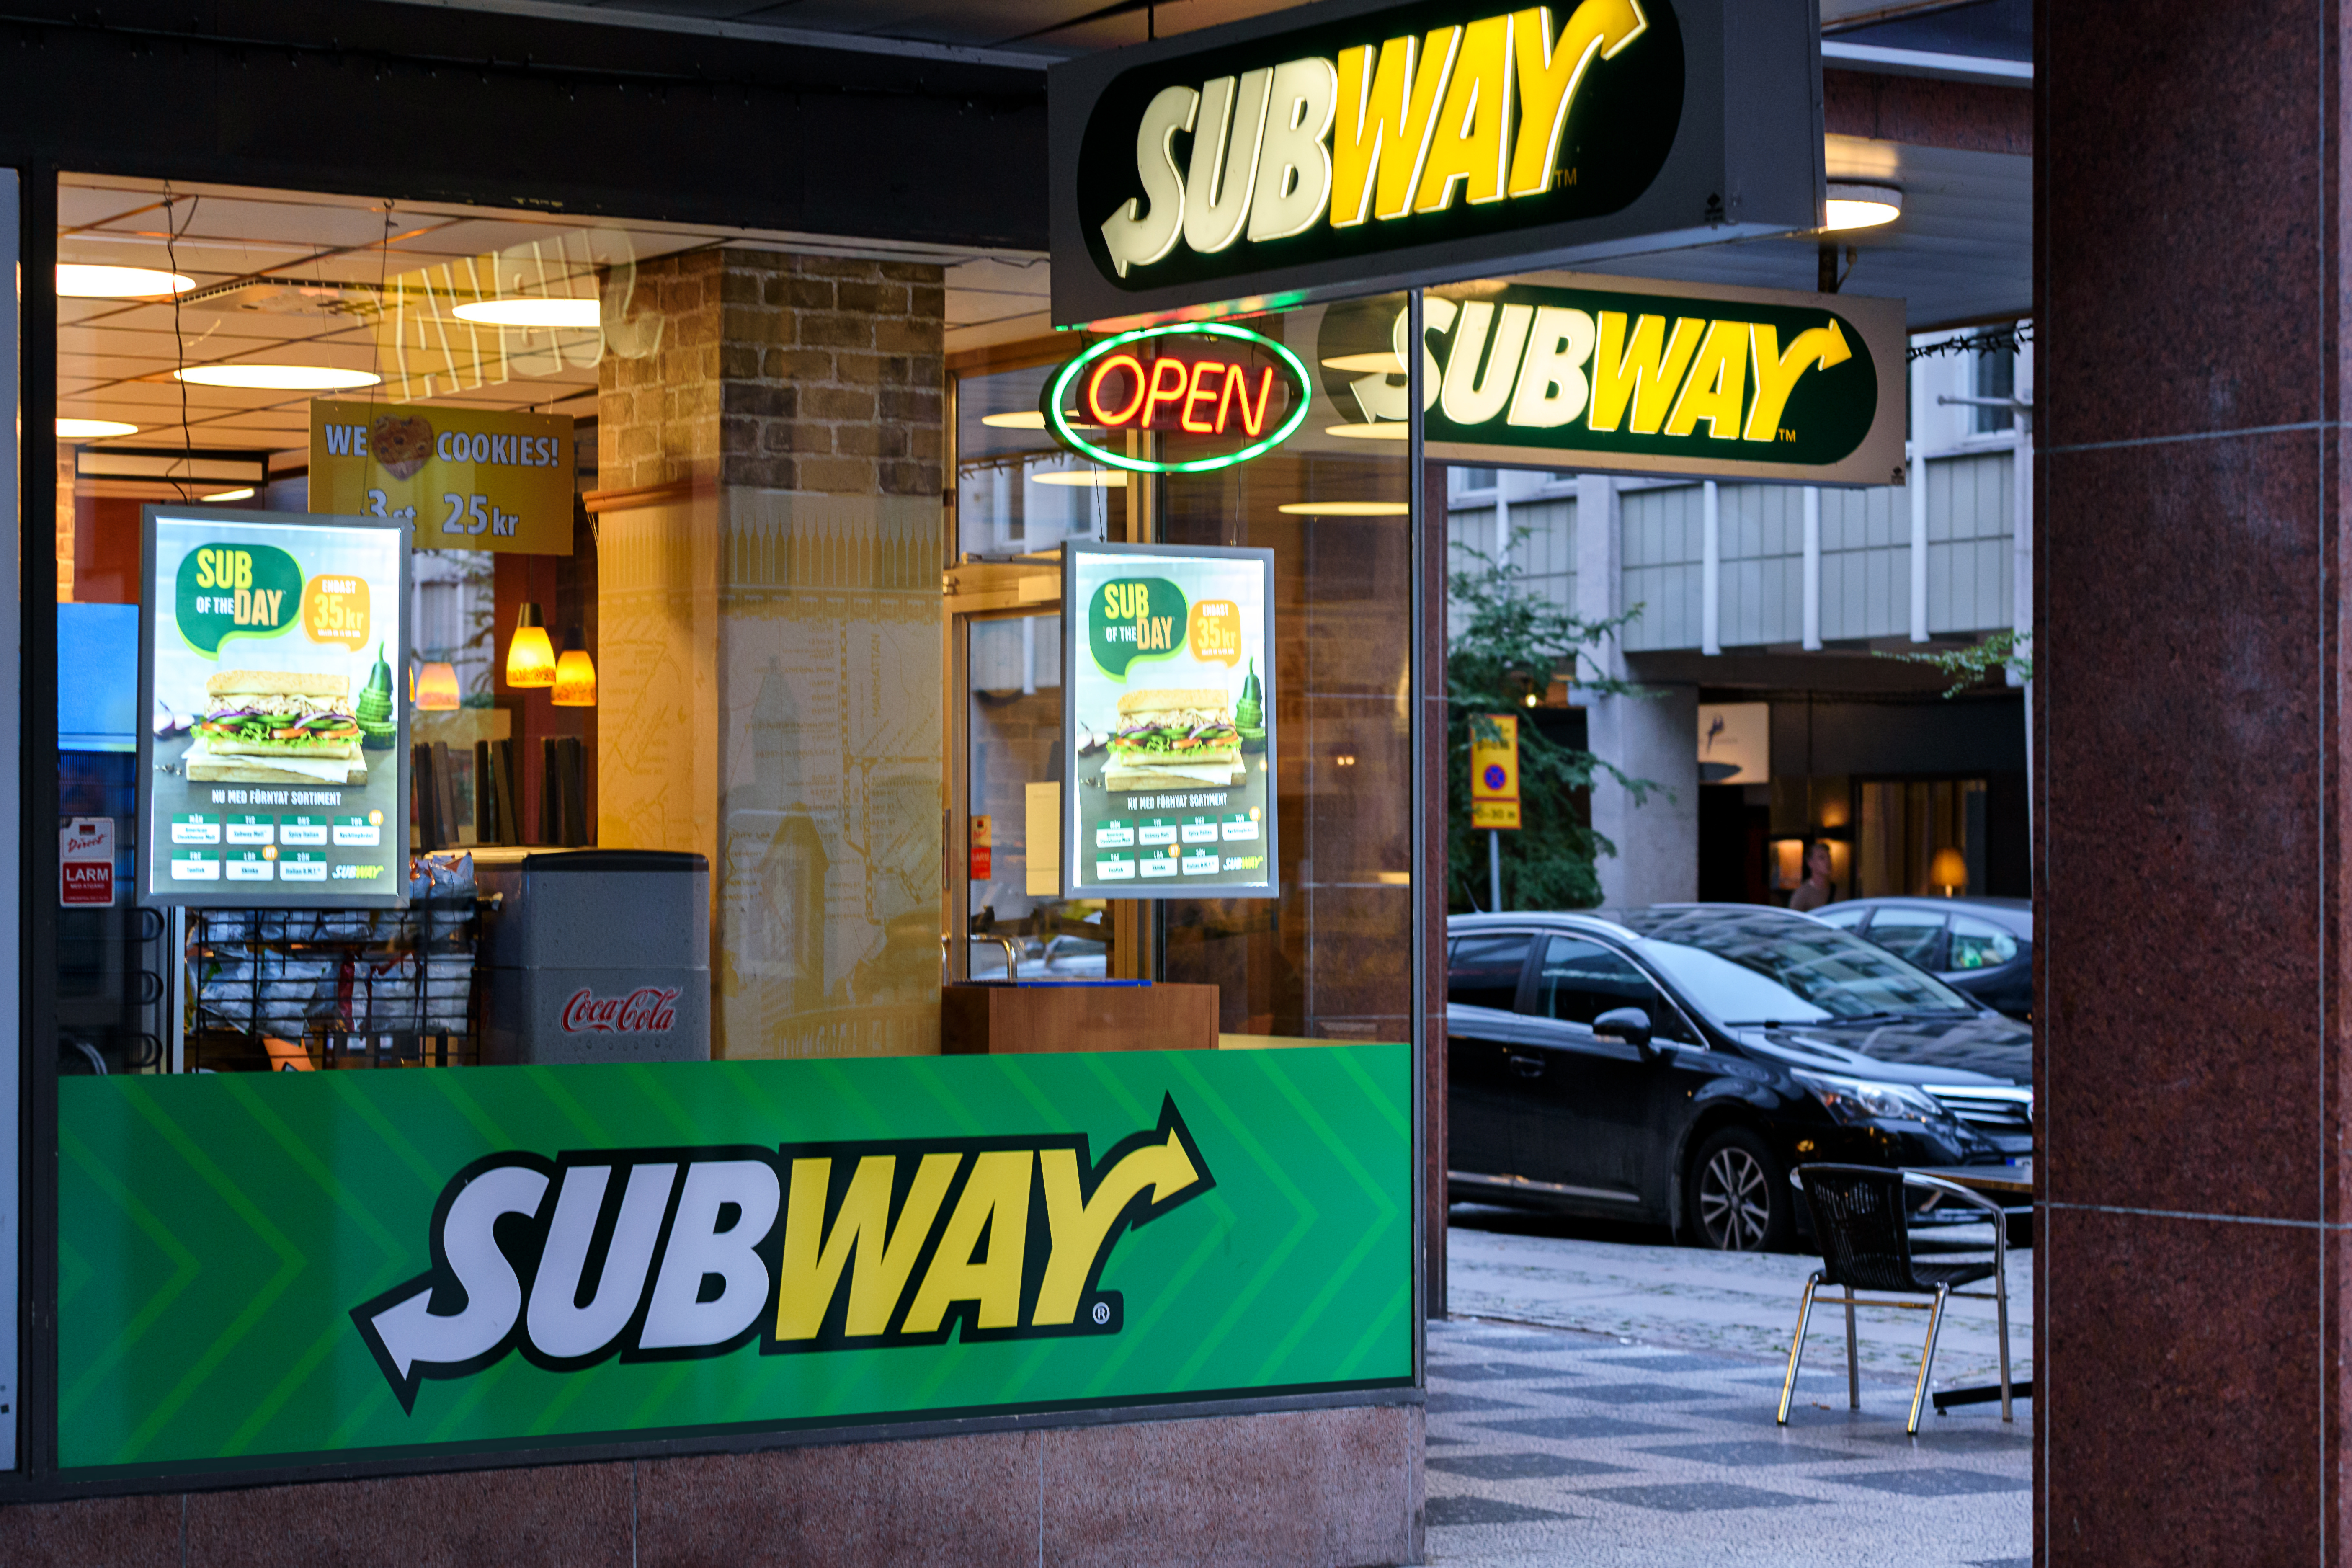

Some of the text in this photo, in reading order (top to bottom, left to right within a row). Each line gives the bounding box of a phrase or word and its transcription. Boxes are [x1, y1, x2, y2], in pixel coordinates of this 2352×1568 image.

[1100, 0, 1648, 279] SUBWAY
[1350, 296, 1853, 443] SUBWAY
[1089, 354, 1273, 437] OPEN
[325, 424, 559, 468] WE COOKIES!
[368, 489, 387, 518] 3
[442, 493, 488, 535] 25
[492, 507, 519, 536] kr
[196, 548, 252, 589] SUB
[322, 579, 356, 594] ENDAST
[196, 588, 283, 626] OF THE DAY
[314, 593, 364, 629] 35 kr
[1104, 583, 1149, 619] SUB
[1106, 616, 1172, 650] OF THE DAY
[1197, 616, 1236, 648] 35 kr
[212, 789, 341, 806] NU MED FÖRNYAT SORTIMENT
[1127, 793, 1227, 810] NU MED FÖRNYAT SORTIMENT
[266, 847, 275, 858] NY
[1223, 855, 1264, 871] SUBWAY
[66, 868, 108, 881] LARM
[332, 864, 384, 879] SUBWAY
[562, 988, 683, 1033] Coca-Cola
[369, 1122, 1202, 1384] SUBWAY
